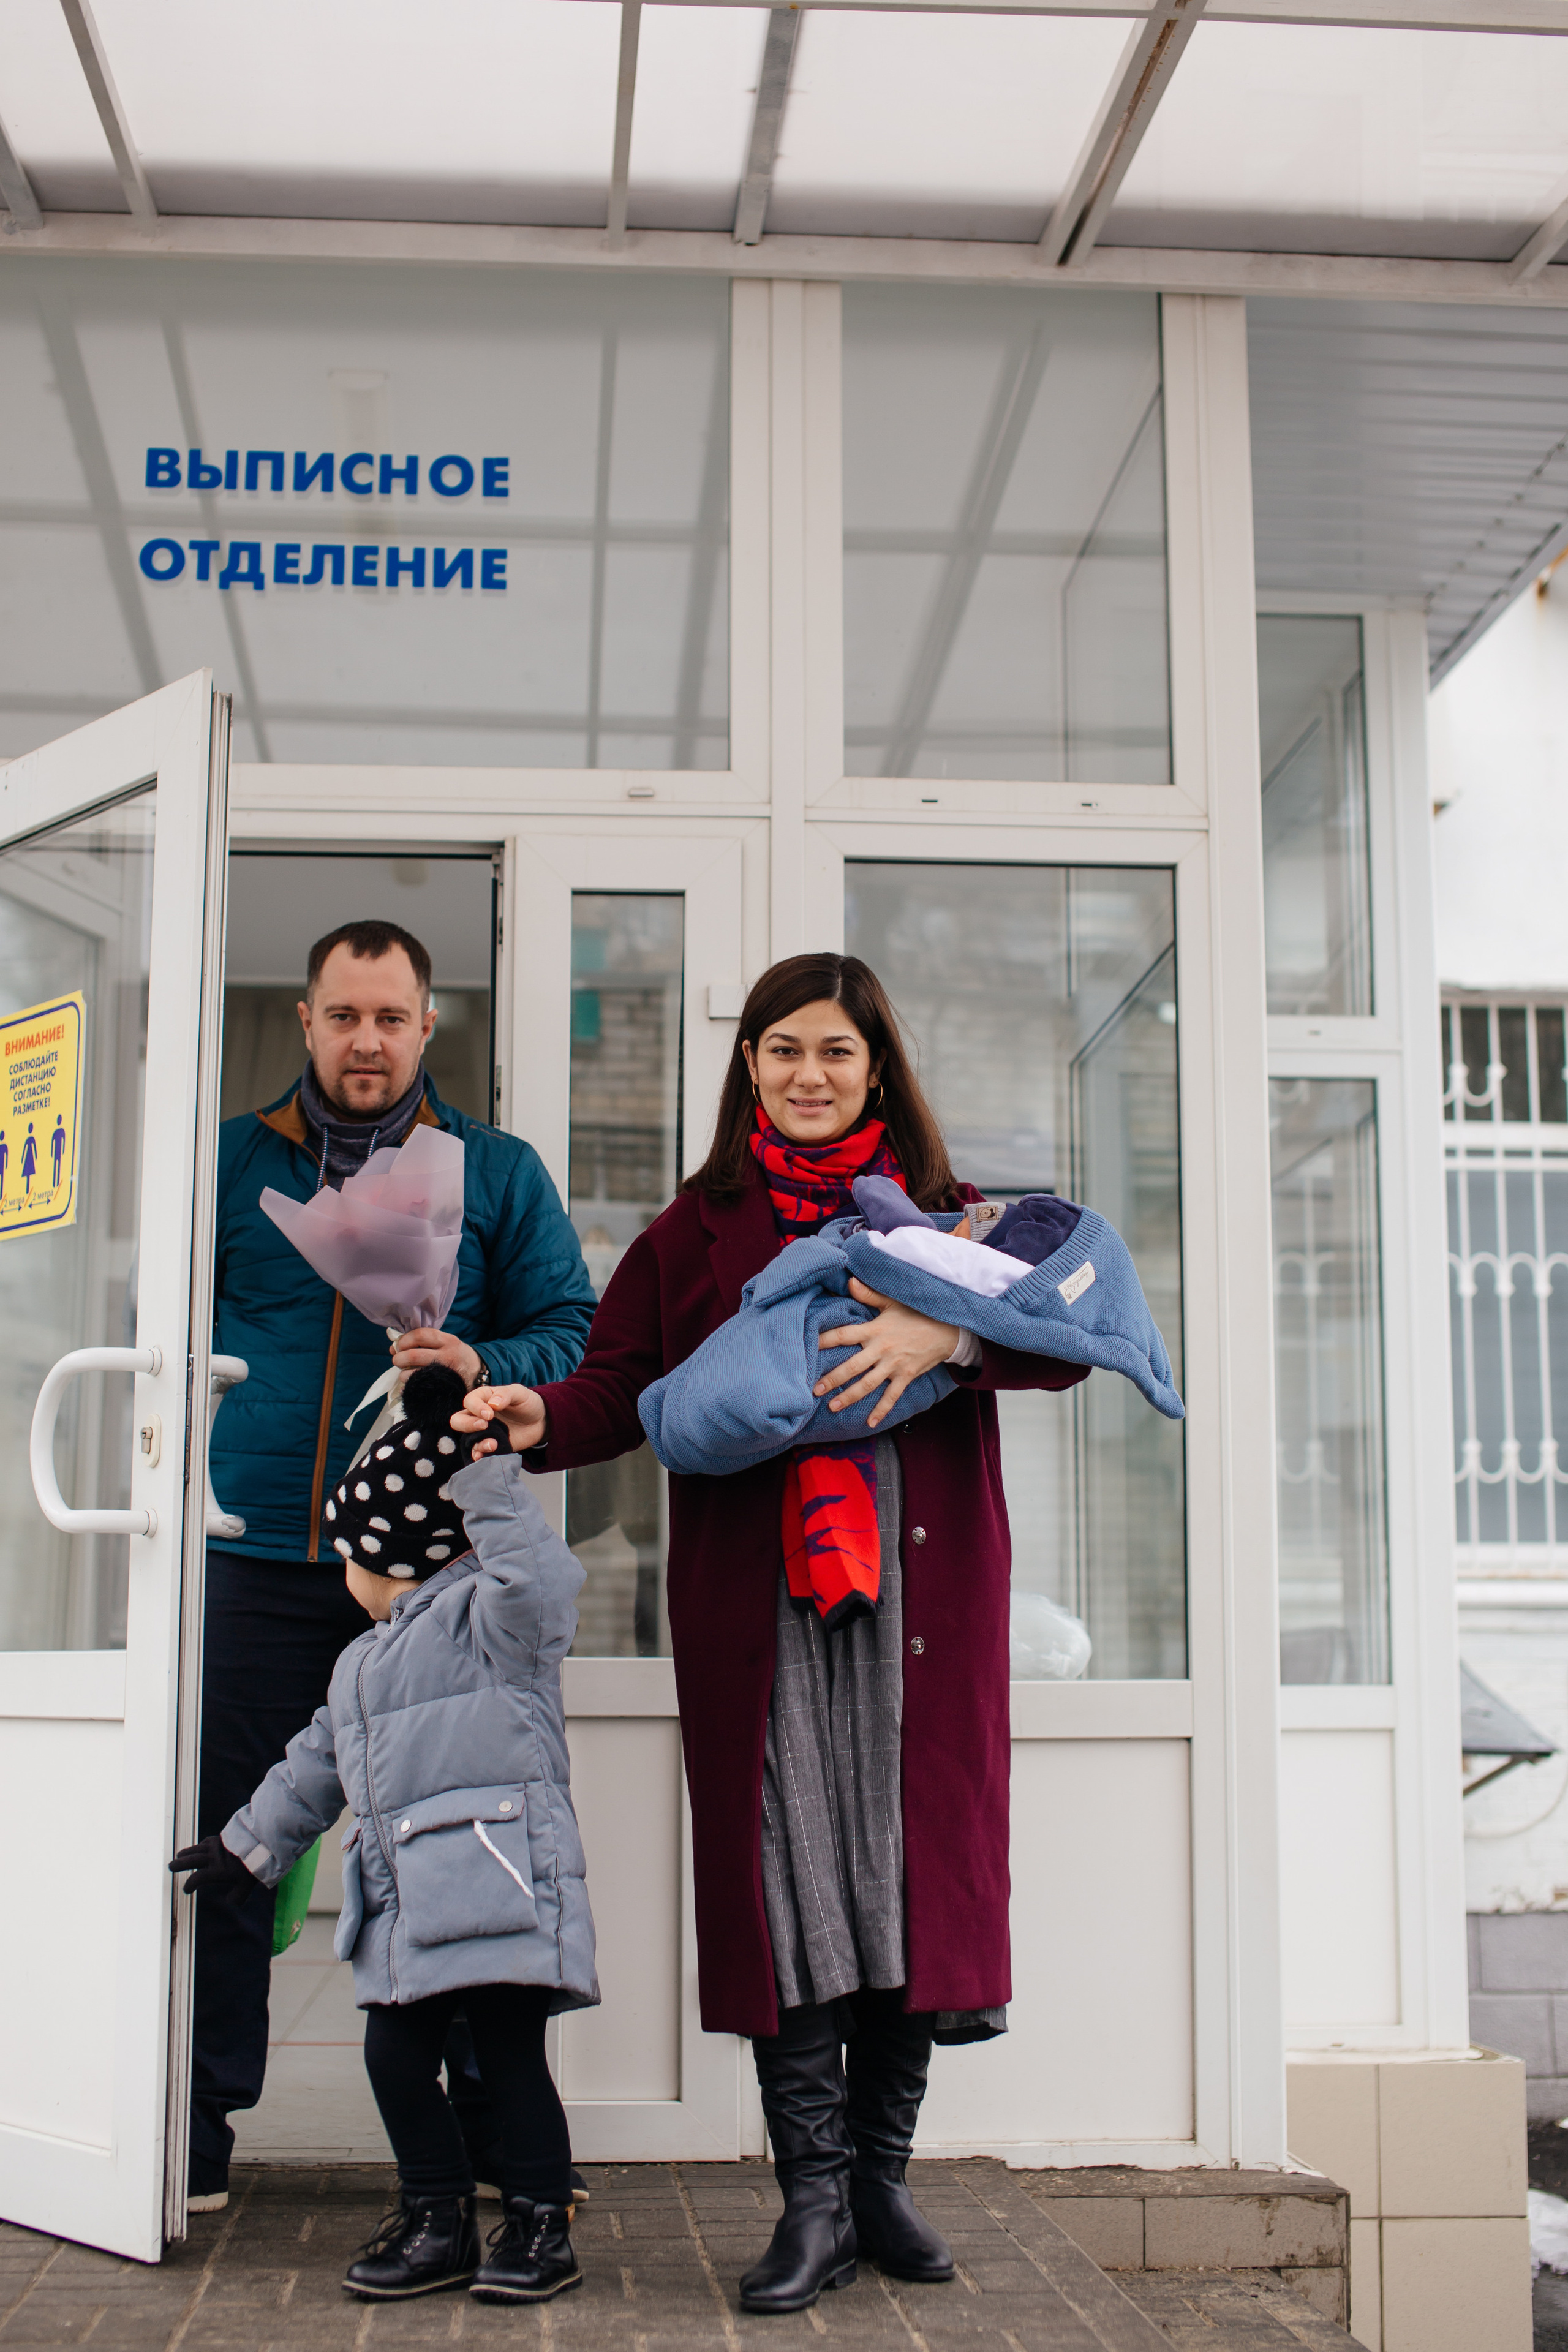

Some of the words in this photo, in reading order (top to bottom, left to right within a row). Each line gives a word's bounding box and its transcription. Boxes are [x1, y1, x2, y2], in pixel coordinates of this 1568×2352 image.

[145, 447, 510, 497] ВЫПИСНОЕ
[139, 538, 507, 590] ОТДЕЛЕНИЕ
[5, 1023, 64, 1057] ВНИМАНИЕ!
[9, 1050, 58, 1075] СОБЛЮДАЙТЕ
[10, 1066, 56, 1091] ДИСТАНЦИЮ
[13, 1082, 51, 1102] СОГЛАСНО
[13, 1096, 50, 1116] РАЗМЕТКЕ!
[9, 1197, 25, 1206] метра
[32, 1192, 36, 1200] 2
[37, 1190, 53, 1199] метра
